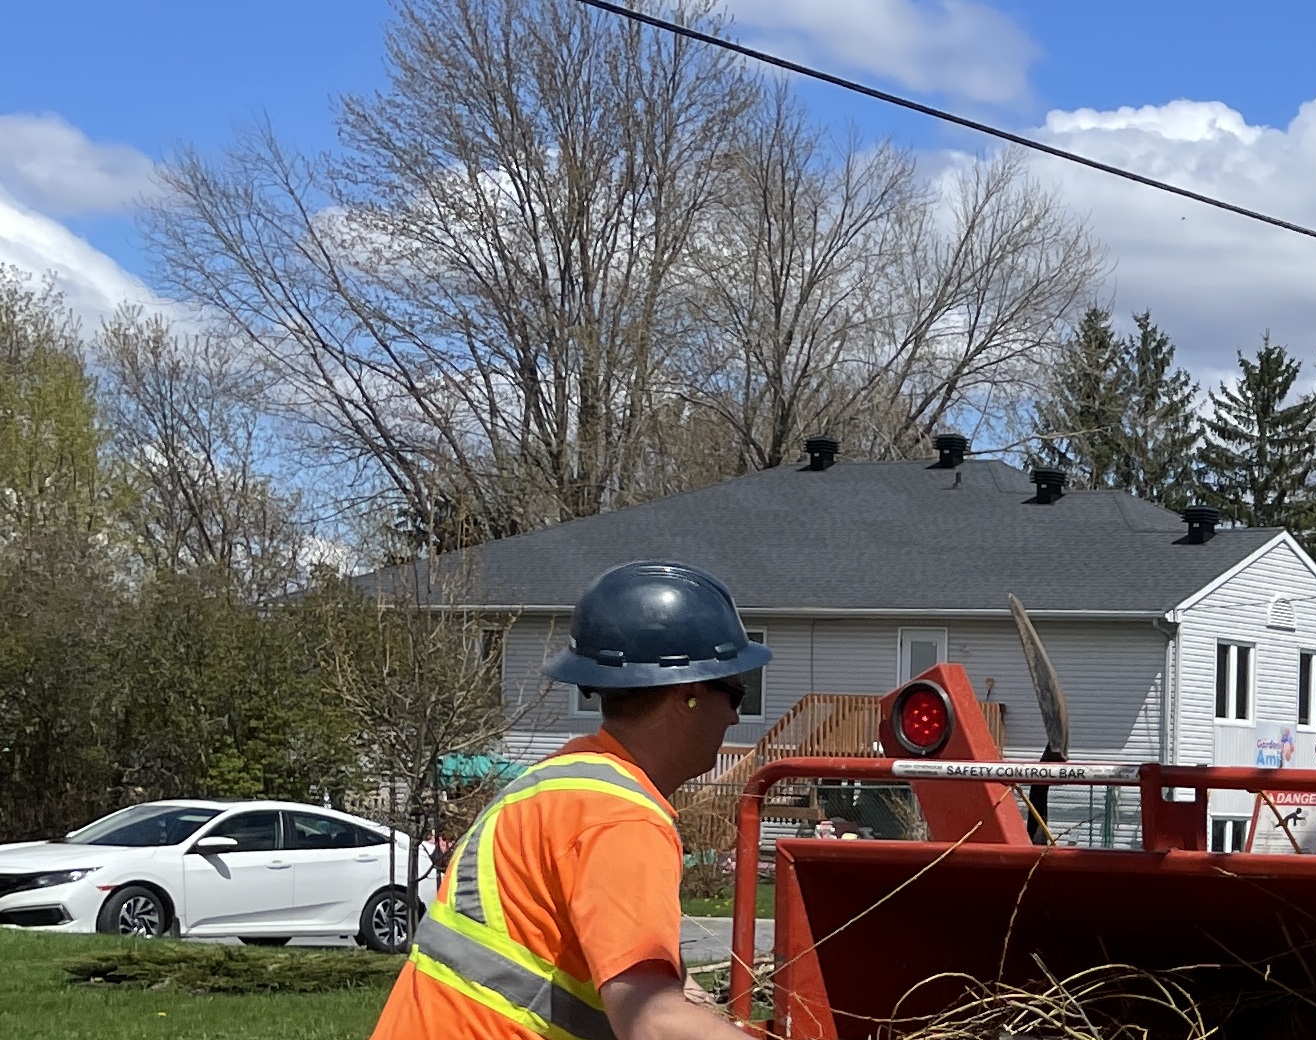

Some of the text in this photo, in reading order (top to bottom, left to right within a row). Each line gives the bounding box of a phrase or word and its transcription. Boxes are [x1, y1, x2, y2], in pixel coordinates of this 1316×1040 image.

[946, 765, 993, 778] SAFETY
[996, 766, 1058, 779] CONTROL
[1059, 769, 1086, 779] BAR
